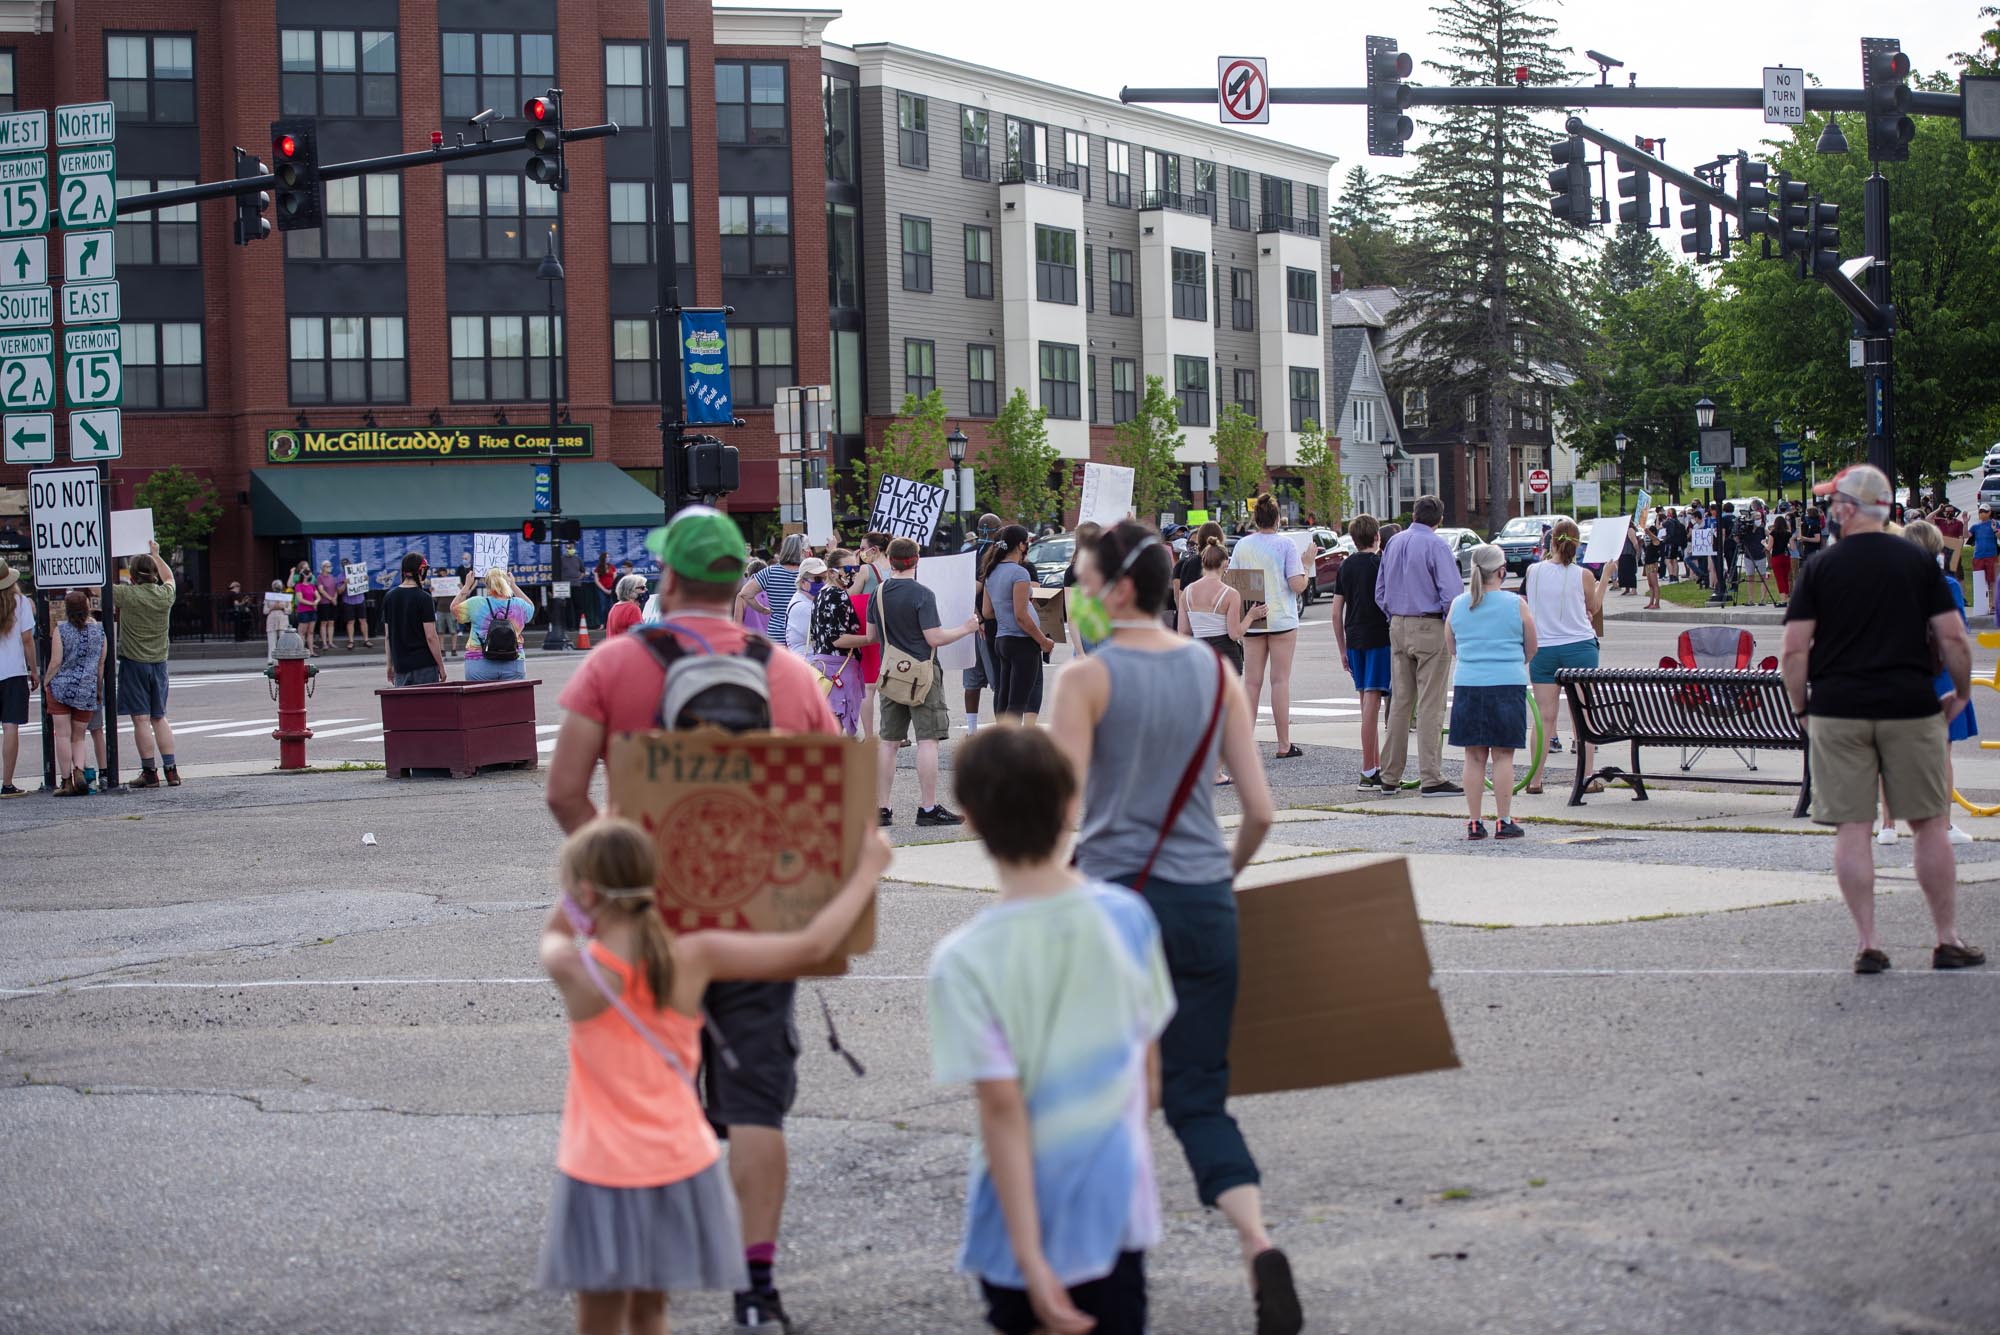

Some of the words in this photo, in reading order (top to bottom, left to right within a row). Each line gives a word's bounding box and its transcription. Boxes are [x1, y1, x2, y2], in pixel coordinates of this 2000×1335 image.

[1776, 75, 1791, 86] NO
[1772, 90, 1796, 101] TURN
[1767, 106, 1780, 117] ON
[1783, 106, 1801, 118] RED
[0, 120, 39, 145] WEST
[59, 112, 111, 138] NORTH
[0, 160, 43, 179] ERMONT
[61, 154, 111, 172] VERMONT
[3, 184, 37, 228] 15
[66, 179, 107, 221] 2A
[0, 295, 49, 320] SOUTH
[69, 291, 110, 316] EAST
[1, 337, 49, 354] VERMONT
[67, 332, 117, 350] VERMONT
[6, 361, 46, 403] 2A
[75, 356, 111, 399] 15
[304, 430, 470, 454] McGillicuddy's
[478, 435, 510, 448] Five
[879, 474, 942, 508] BLACK
[1694, 476, 1715, 485] BEGI
[33, 482, 56, 509] DO
[62, 480, 95, 508] NOT
[874, 493, 933, 525] LIVES
[36, 520, 98, 549] BLOCK
[870, 513, 929, 547] MATTER
[1695, 530, 1713, 539] BLA
[475, 534, 509, 556] BLACK
[37, 556, 101, 576] INTERSECTION
[474, 553, 507, 568] LIVES
[539, 564, 552, 572] Ess
[647, 741, 753, 782] Pizza
